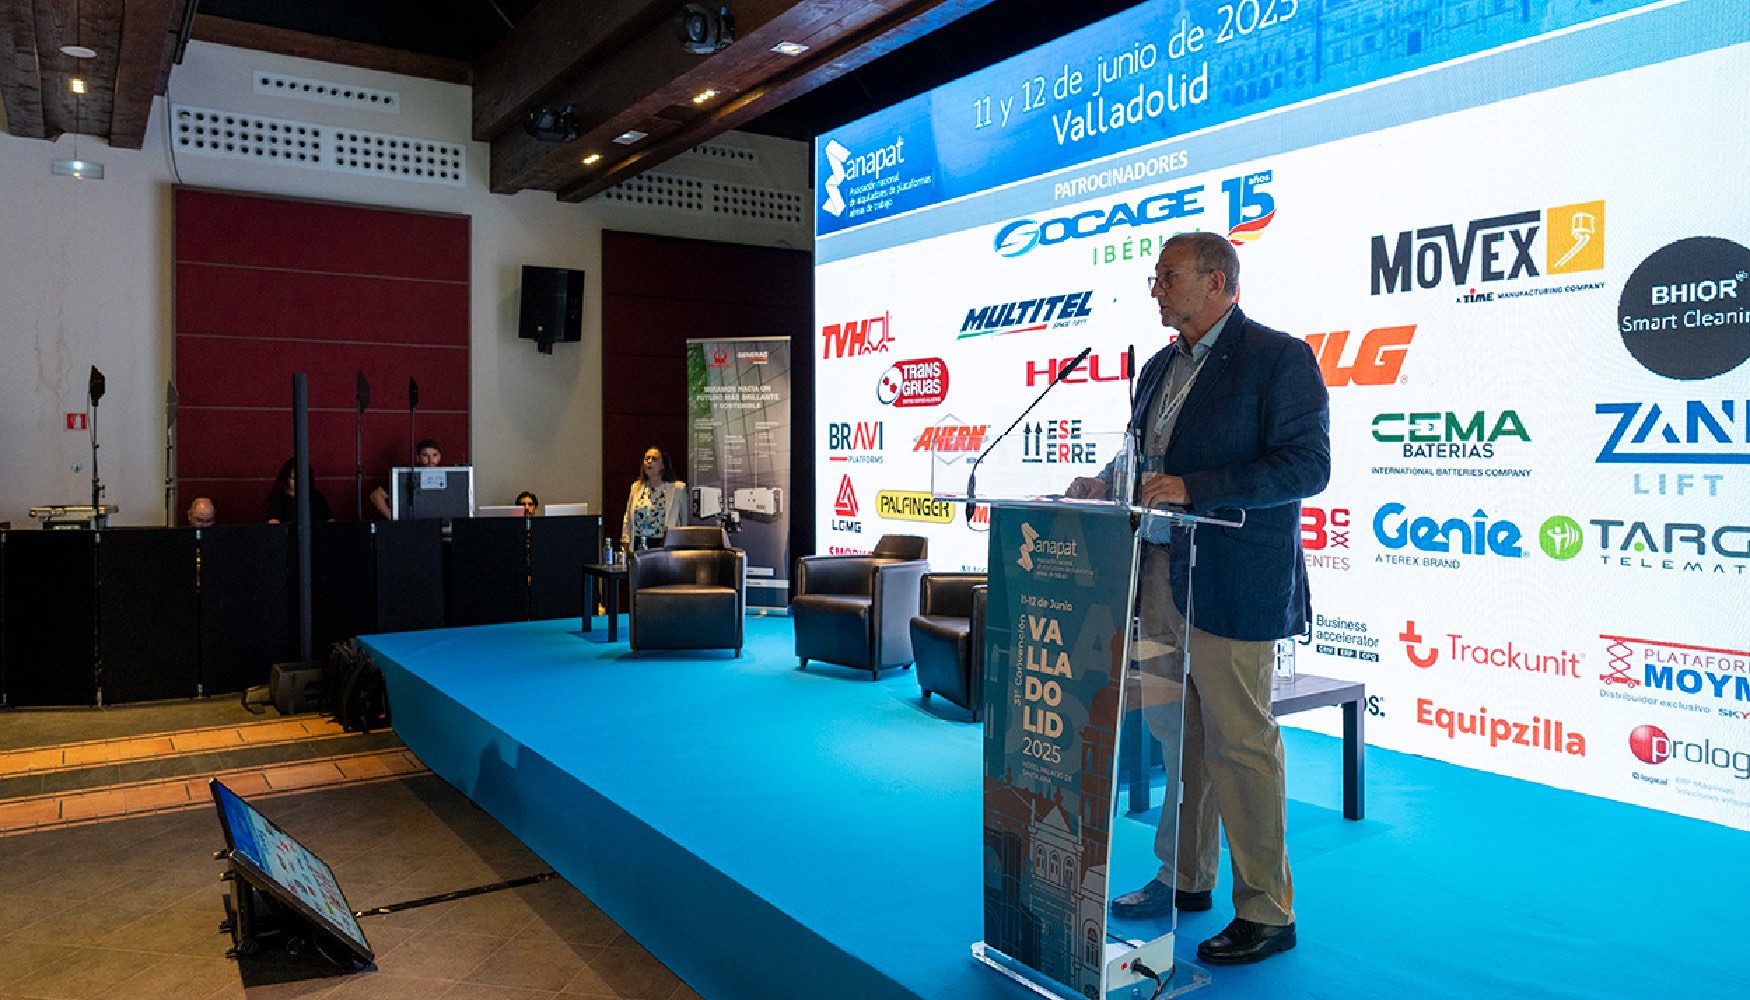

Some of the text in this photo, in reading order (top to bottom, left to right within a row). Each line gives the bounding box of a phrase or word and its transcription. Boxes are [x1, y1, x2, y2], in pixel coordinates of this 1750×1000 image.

[973, 95, 992, 129] 11
[1000, 95, 1013, 128] y
[1021, 76, 1047, 112] 12
[1053, 64, 1083, 100] de
[1092, 42, 1157, 97] junio
[1168, 18, 1204, 59] de
[1053, 61, 1208, 146] Valladolid
[1054, 150, 1189, 202] PATROCINADORES
[1221, 170, 1275, 232] 15
[1497, 286, 1563, 299] MANUFACTURING
[1564, 281, 1605, 293] COMPANY
[959, 289, 1093, 332] MULTITEL
[1622, 314, 1678, 333] Smart
[822, 319, 868, 359] TVH
[829, 421, 883, 451] BRAVI
[913, 424, 988, 453] AHERN
[1047, 419, 1082, 440] ESE
[1371, 410, 1533, 443] CEMA
[1595, 400, 1750, 464] ZAN
[1047, 442, 1097, 464] ERRE
[1402, 442, 1494, 458] BATERIAS
[1371, 466, 1533, 478] INTERNATIONAL BATTERIES COMPANY
[1633, 473, 1724, 496] LIFT
[880, 496, 950, 519] PALFINGER
[1385, 554, 1420, 566] TEREX
[1422, 557, 1461, 570] BRAND
[1037, 597, 1048, 608] de
[1028, 614, 1064, 646] VA
[1316, 613, 1367, 632] Business
[1316, 630, 1380, 649] accelerator
[1026, 645, 1073, 679] LLA
[1446, 633, 1582, 679] Trackunit
[1644, 648, 1750, 675] PLATAFOR
[1024, 675, 1062, 707] DO
[1599, 689, 1659, 706] Distribuidor
[1660, 700, 1712, 714] exclusivo
[1022, 705, 1064, 739] LID
[1417, 697, 1586, 757] Equipzilla
[1022, 736, 1061, 764] 2025
